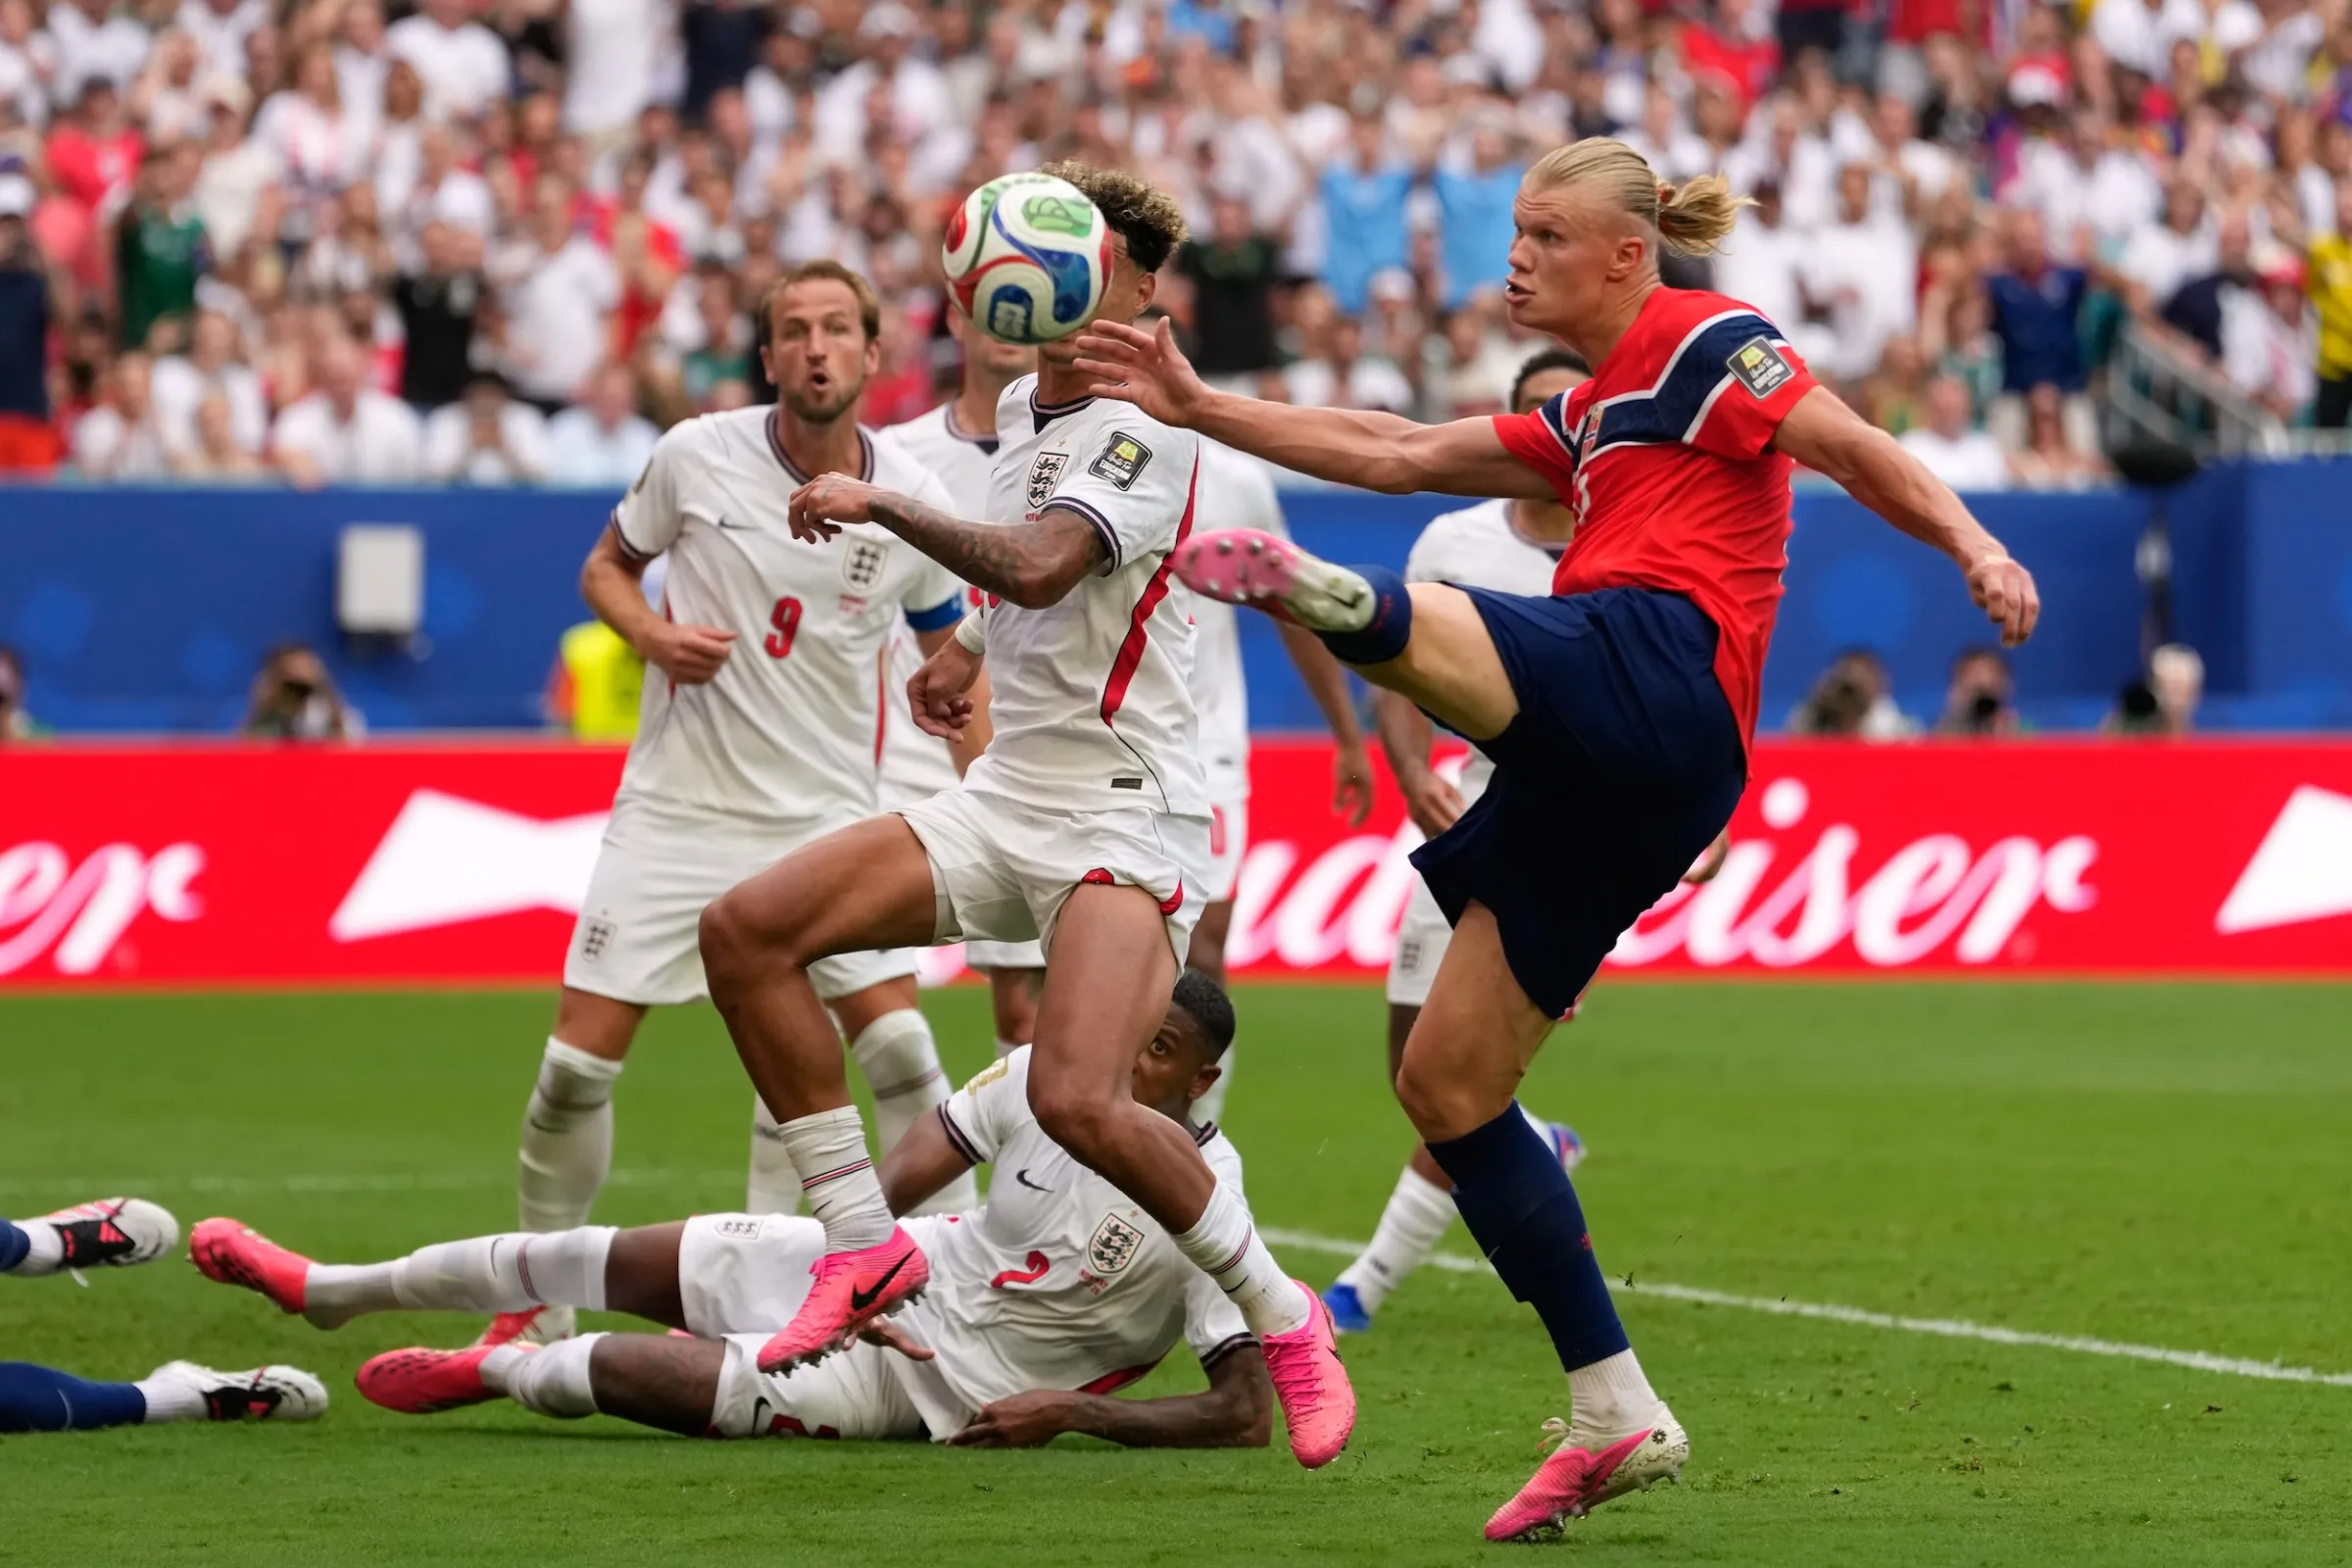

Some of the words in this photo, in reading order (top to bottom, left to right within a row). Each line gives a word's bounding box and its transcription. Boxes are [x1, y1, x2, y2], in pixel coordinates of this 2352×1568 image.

[1099, 459, 1132, 480] EDUCATION
[764, 596, 803, 660] 9
[991, 1250, 1051, 1290] 2
